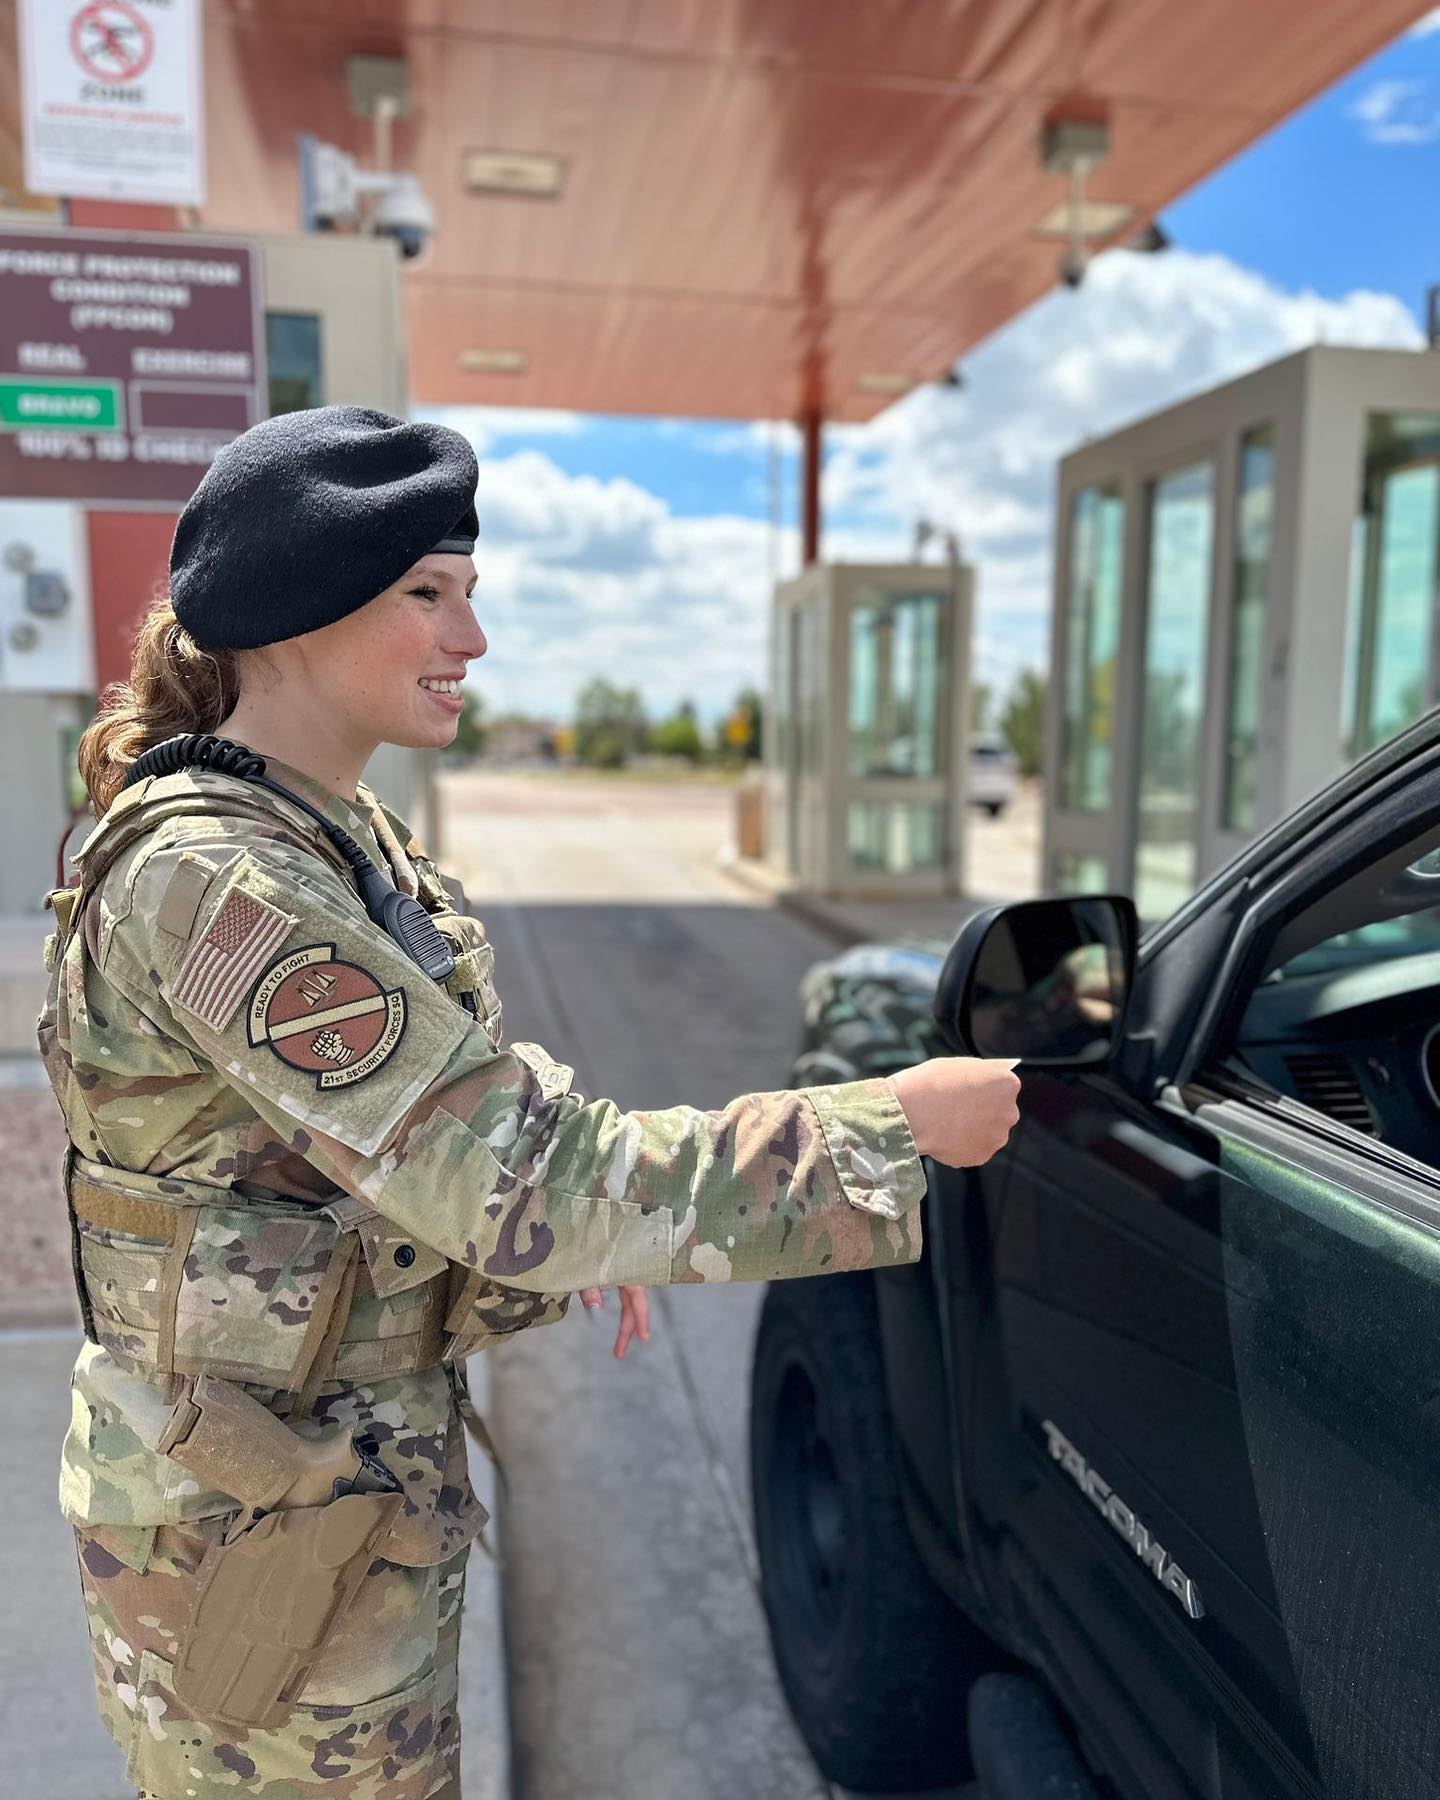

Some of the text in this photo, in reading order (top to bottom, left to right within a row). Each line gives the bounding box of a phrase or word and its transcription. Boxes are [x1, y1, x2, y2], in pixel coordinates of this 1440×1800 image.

[0, 251, 240, 285] FORCE PROTECTION
[51, 279, 190, 307] CONDITION
[71, 305, 173, 335] (FPCON)
[18, 343, 250, 377] REAL EXERCISE
[18, 394, 100, 418] BRAVO
[95, 436, 129, 461] ID
[255, 953, 310, 1019] READY TO FIGHT
[393, 995, 401, 1009] SQ
[386, 1010, 401, 1045] FORCES
[347, 1046, 387, 1079] SECURITY
[1041, 1419, 1204, 1618] TACOMA
